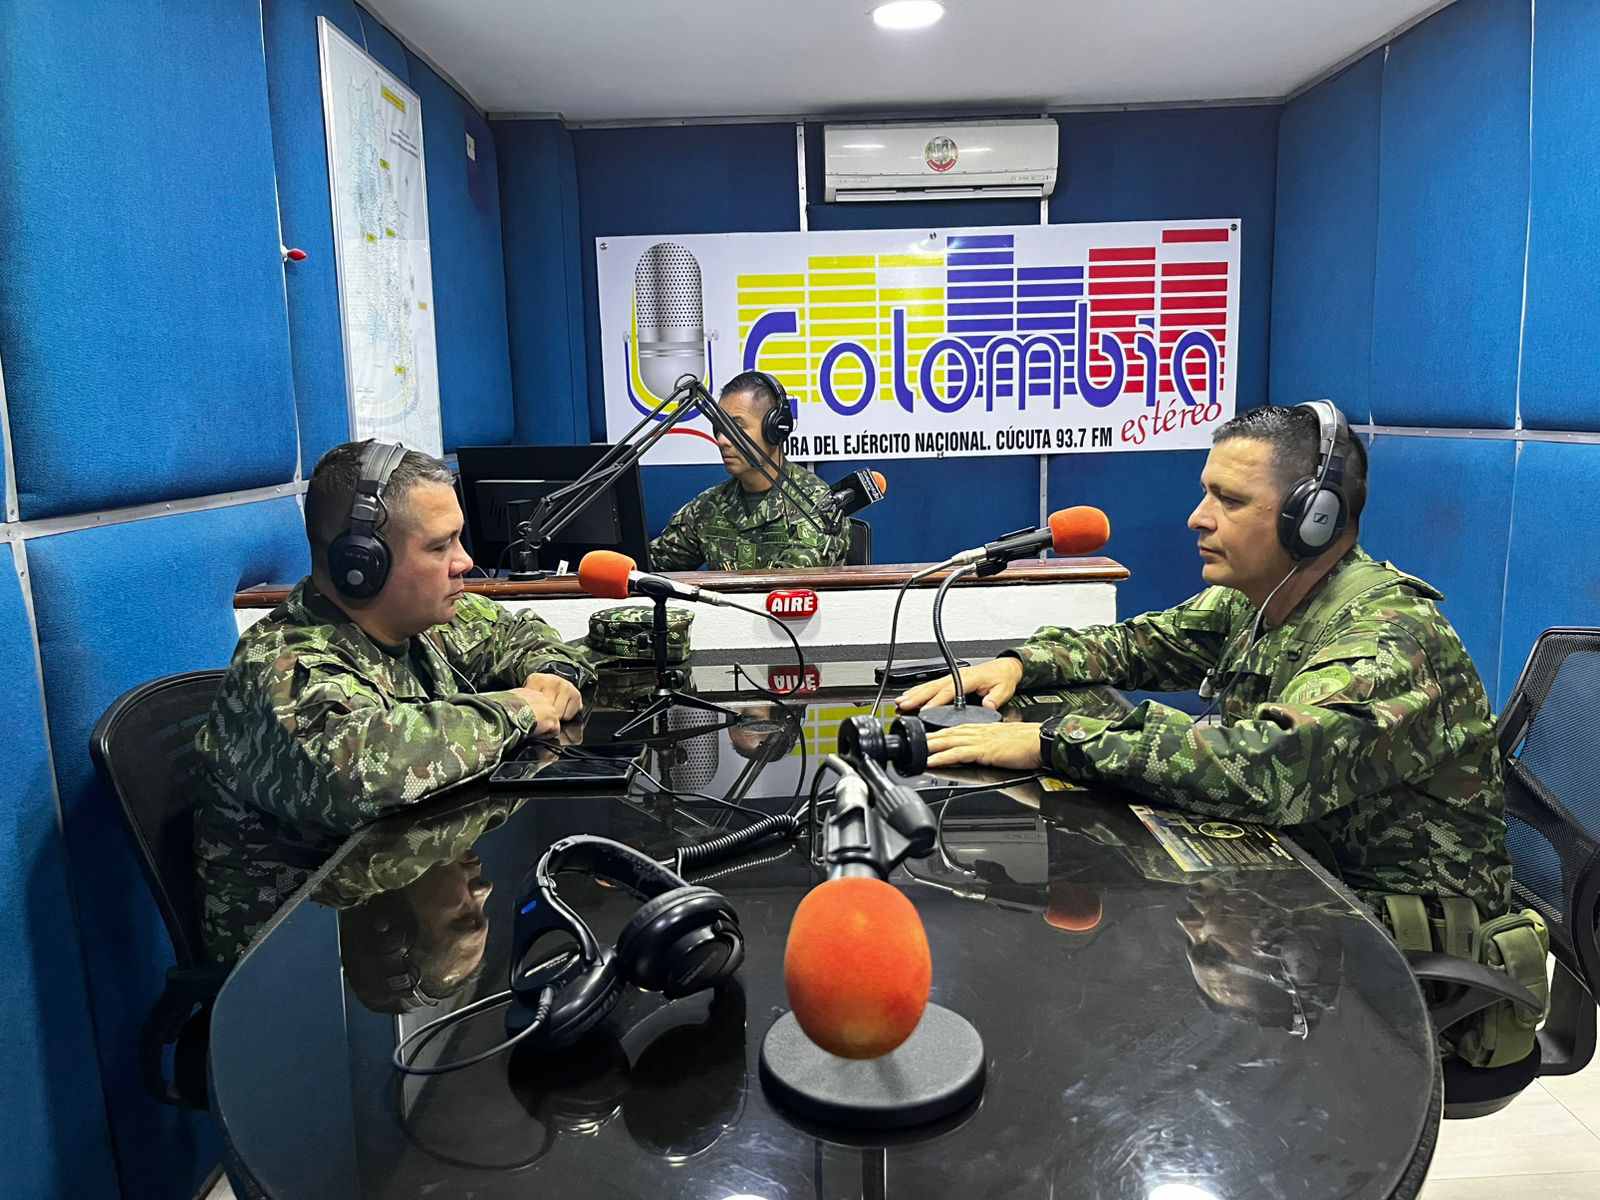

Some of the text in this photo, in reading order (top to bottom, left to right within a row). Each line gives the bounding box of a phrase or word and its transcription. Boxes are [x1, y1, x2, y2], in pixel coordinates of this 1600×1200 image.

[743, 299, 1220, 420] Colombia
[1121, 398, 1222, 444] estéreo
[814, 435, 840, 455] DEL
[844, 430, 910, 454] EJÉRCITO
[915, 431, 991, 452] NACIONAL.
[996, 426, 1051, 450] CÚCUTA
[1056, 428, 1087, 448] 93.7
[1091, 426, 1113, 447] FM
[771, 595, 814, 612] AIRE
